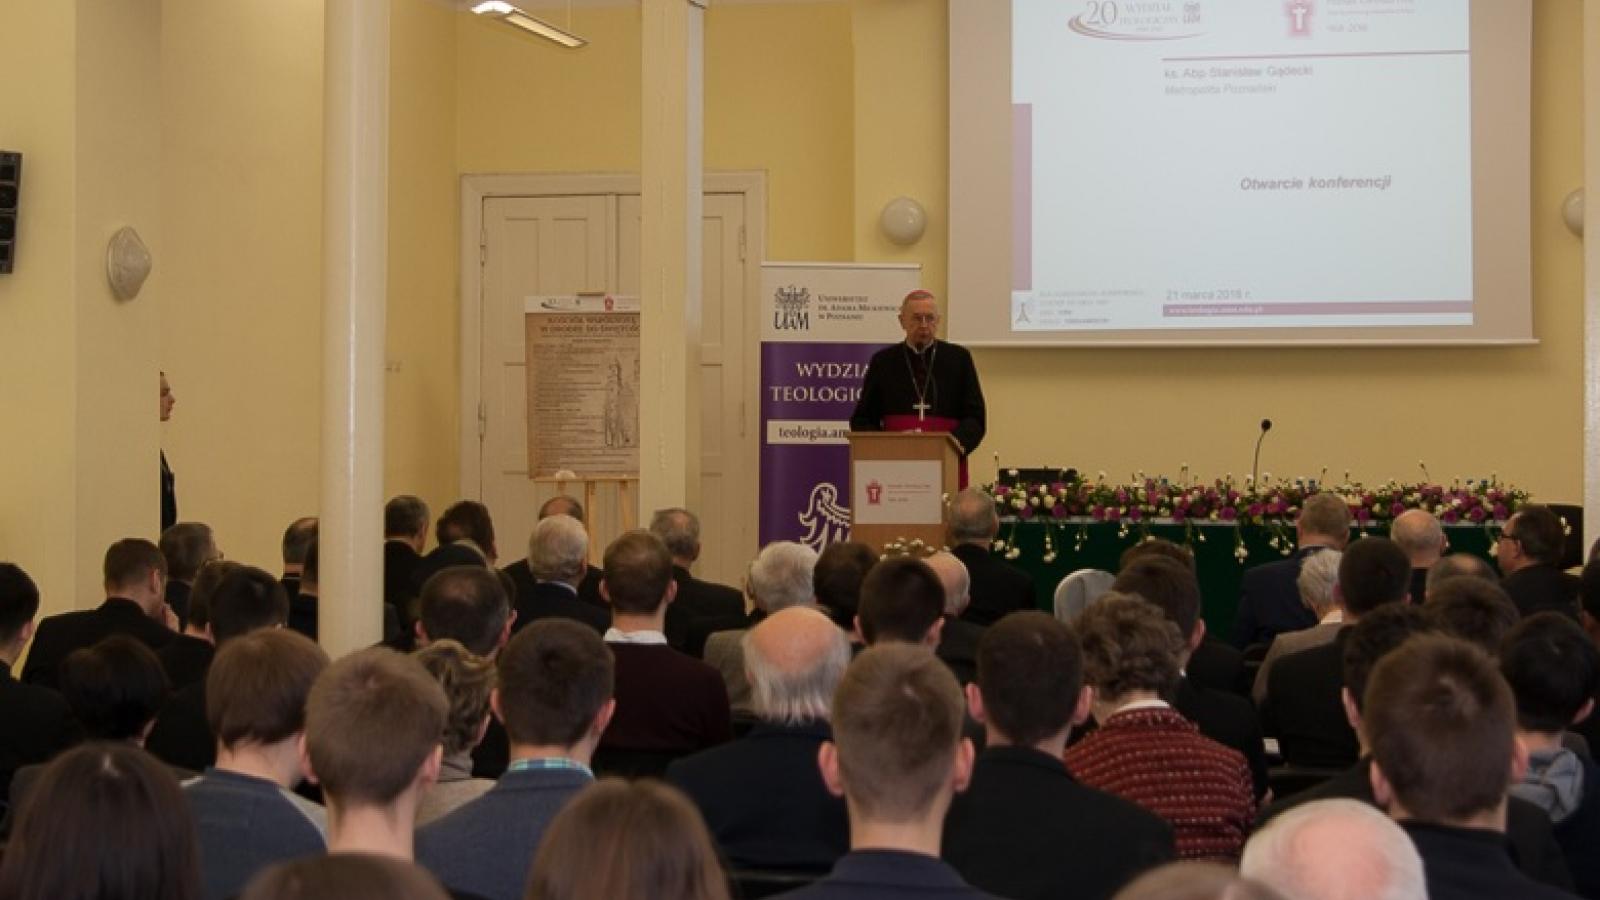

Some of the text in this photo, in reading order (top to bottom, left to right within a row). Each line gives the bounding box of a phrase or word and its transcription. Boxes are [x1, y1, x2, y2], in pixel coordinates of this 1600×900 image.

[1086, 0, 1118, 25] 20
[1183, 67, 1206, 79] Abp
[1240, 174, 1392, 191] Otwarcie konferencji
[1166, 289, 1178, 300] 21
[1181, 290, 1215, 300] marca
